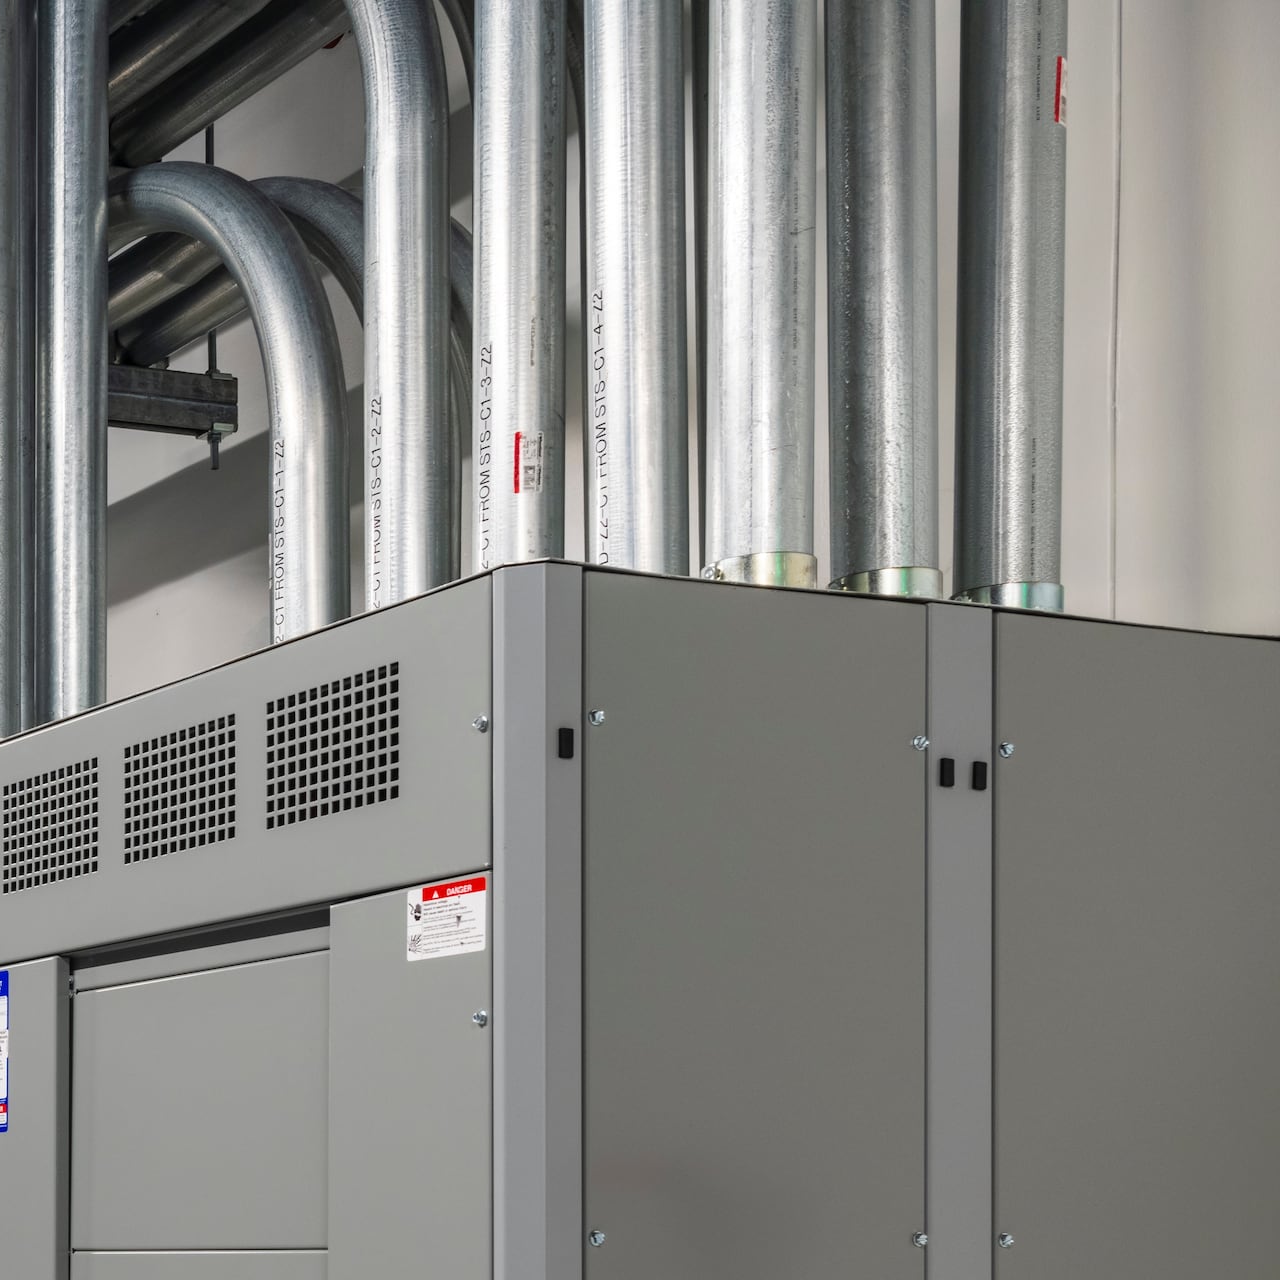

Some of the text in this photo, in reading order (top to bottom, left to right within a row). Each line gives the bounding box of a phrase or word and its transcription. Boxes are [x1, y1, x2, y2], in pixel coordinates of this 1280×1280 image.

[479, 345, 492, 466] STS-C1-3-Z2
[592, 290, 607, 418] STS-C1-4-Z2
[274, 439, 285, 548] STS-C1-1-Z2
[370, 398, 382, 510] STS-C1-2-Z2
[479, 469, 491, 523] FROM
[274, 552, 285, 601] FROM
[446, 884, 472, 896] DANGER
